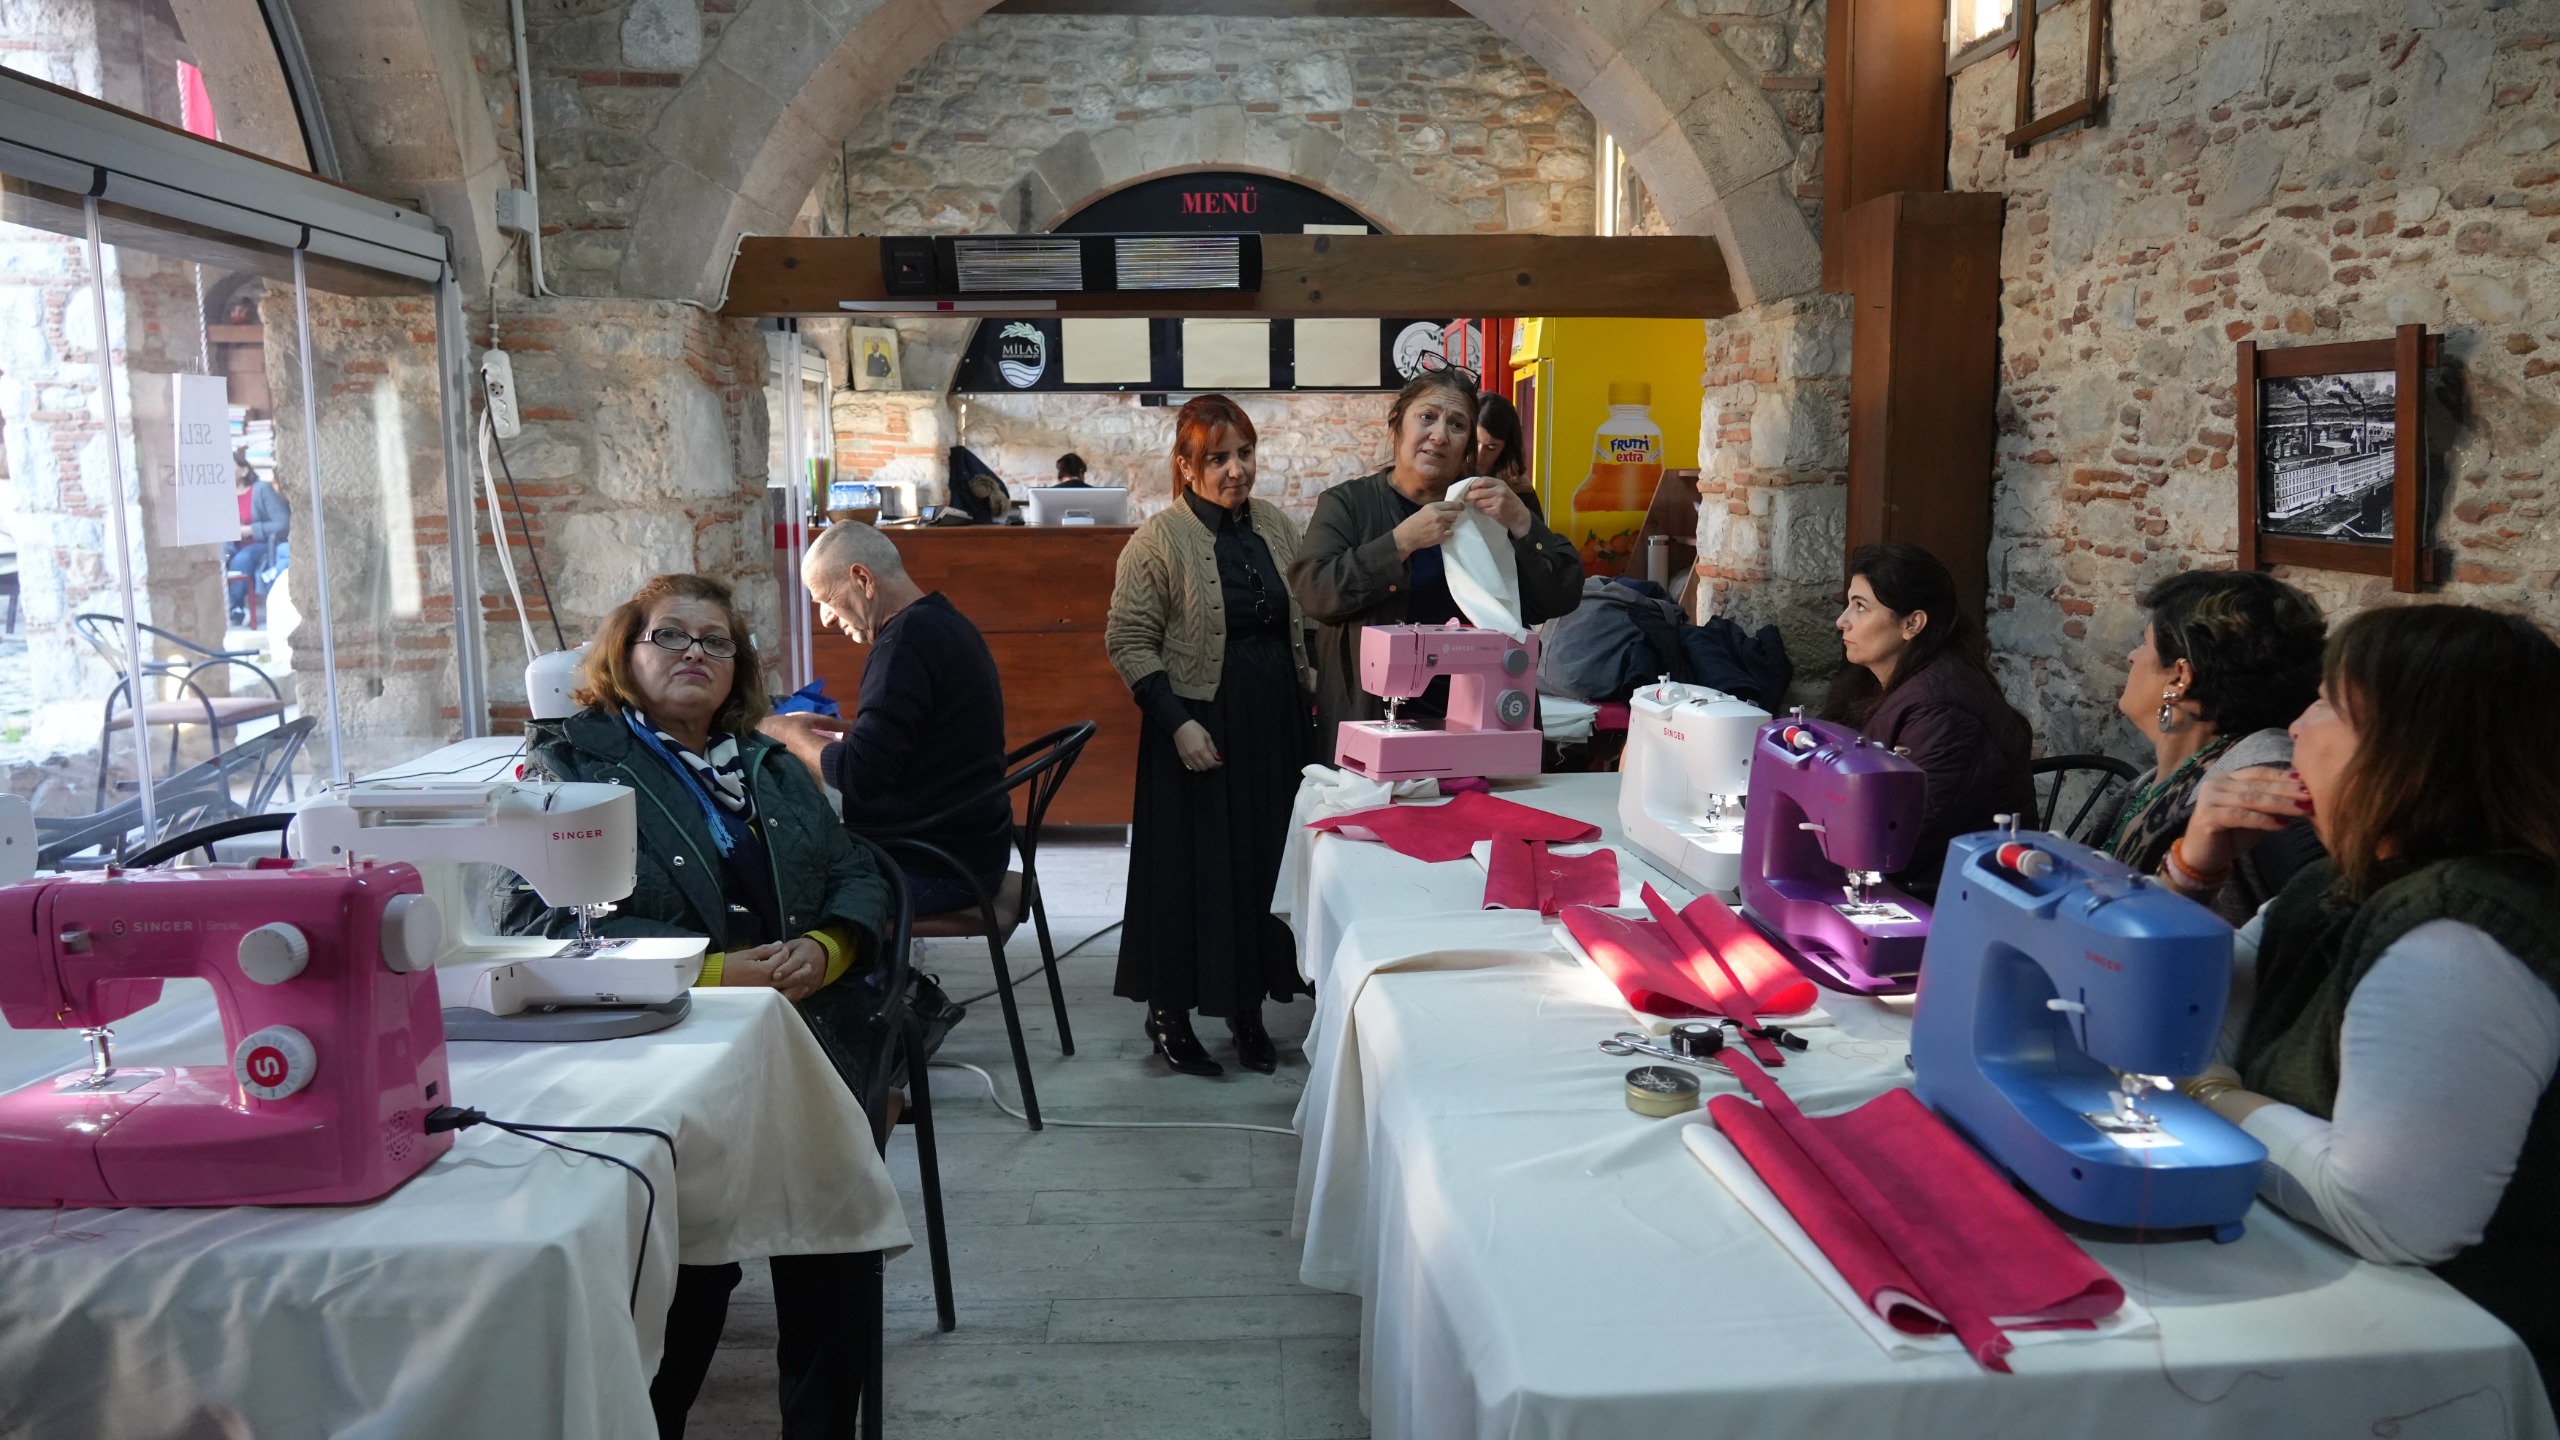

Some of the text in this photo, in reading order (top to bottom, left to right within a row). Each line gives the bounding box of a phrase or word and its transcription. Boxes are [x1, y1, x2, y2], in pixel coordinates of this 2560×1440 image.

[1181, 186, 1258, 214] MENÜ
[1002, 343, 1040, 355] MİLAS
[1616, 451, 1644, 463] extra
[1663, 727, 1685, 741] SINGER
[552, 829, 602, 841] SINGER
[133, 921, 193, 932] SINGER
[255, 1056, 280, 1078] S
